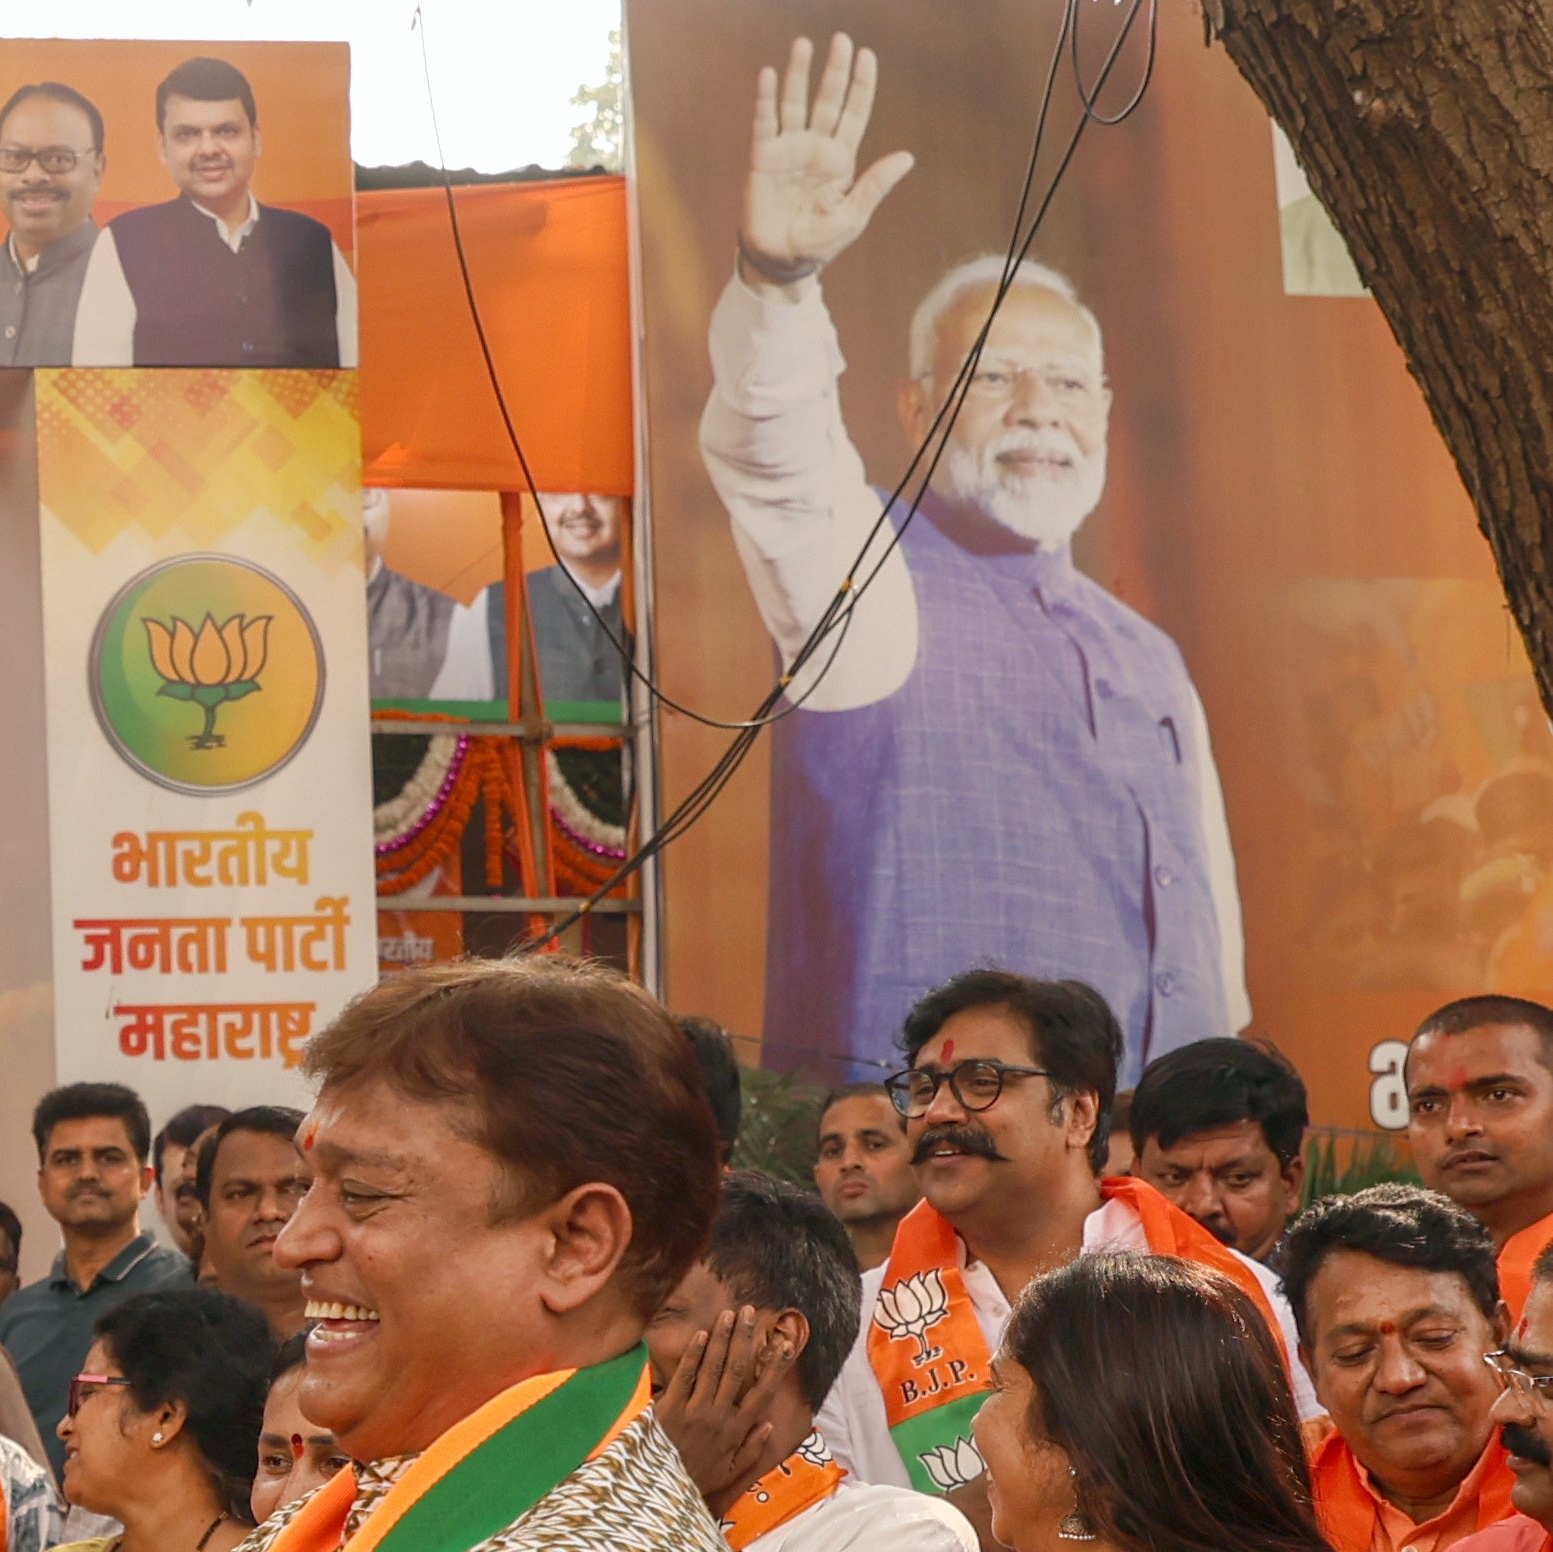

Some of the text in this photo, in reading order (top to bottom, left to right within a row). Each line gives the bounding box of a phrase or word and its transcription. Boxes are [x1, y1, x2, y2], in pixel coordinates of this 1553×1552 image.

[111, 810, 314, 887] भारतीय
[73, 895, 351, 975] जनता पार्टी
[898, 1358, 978, 1406] B.J.P.
